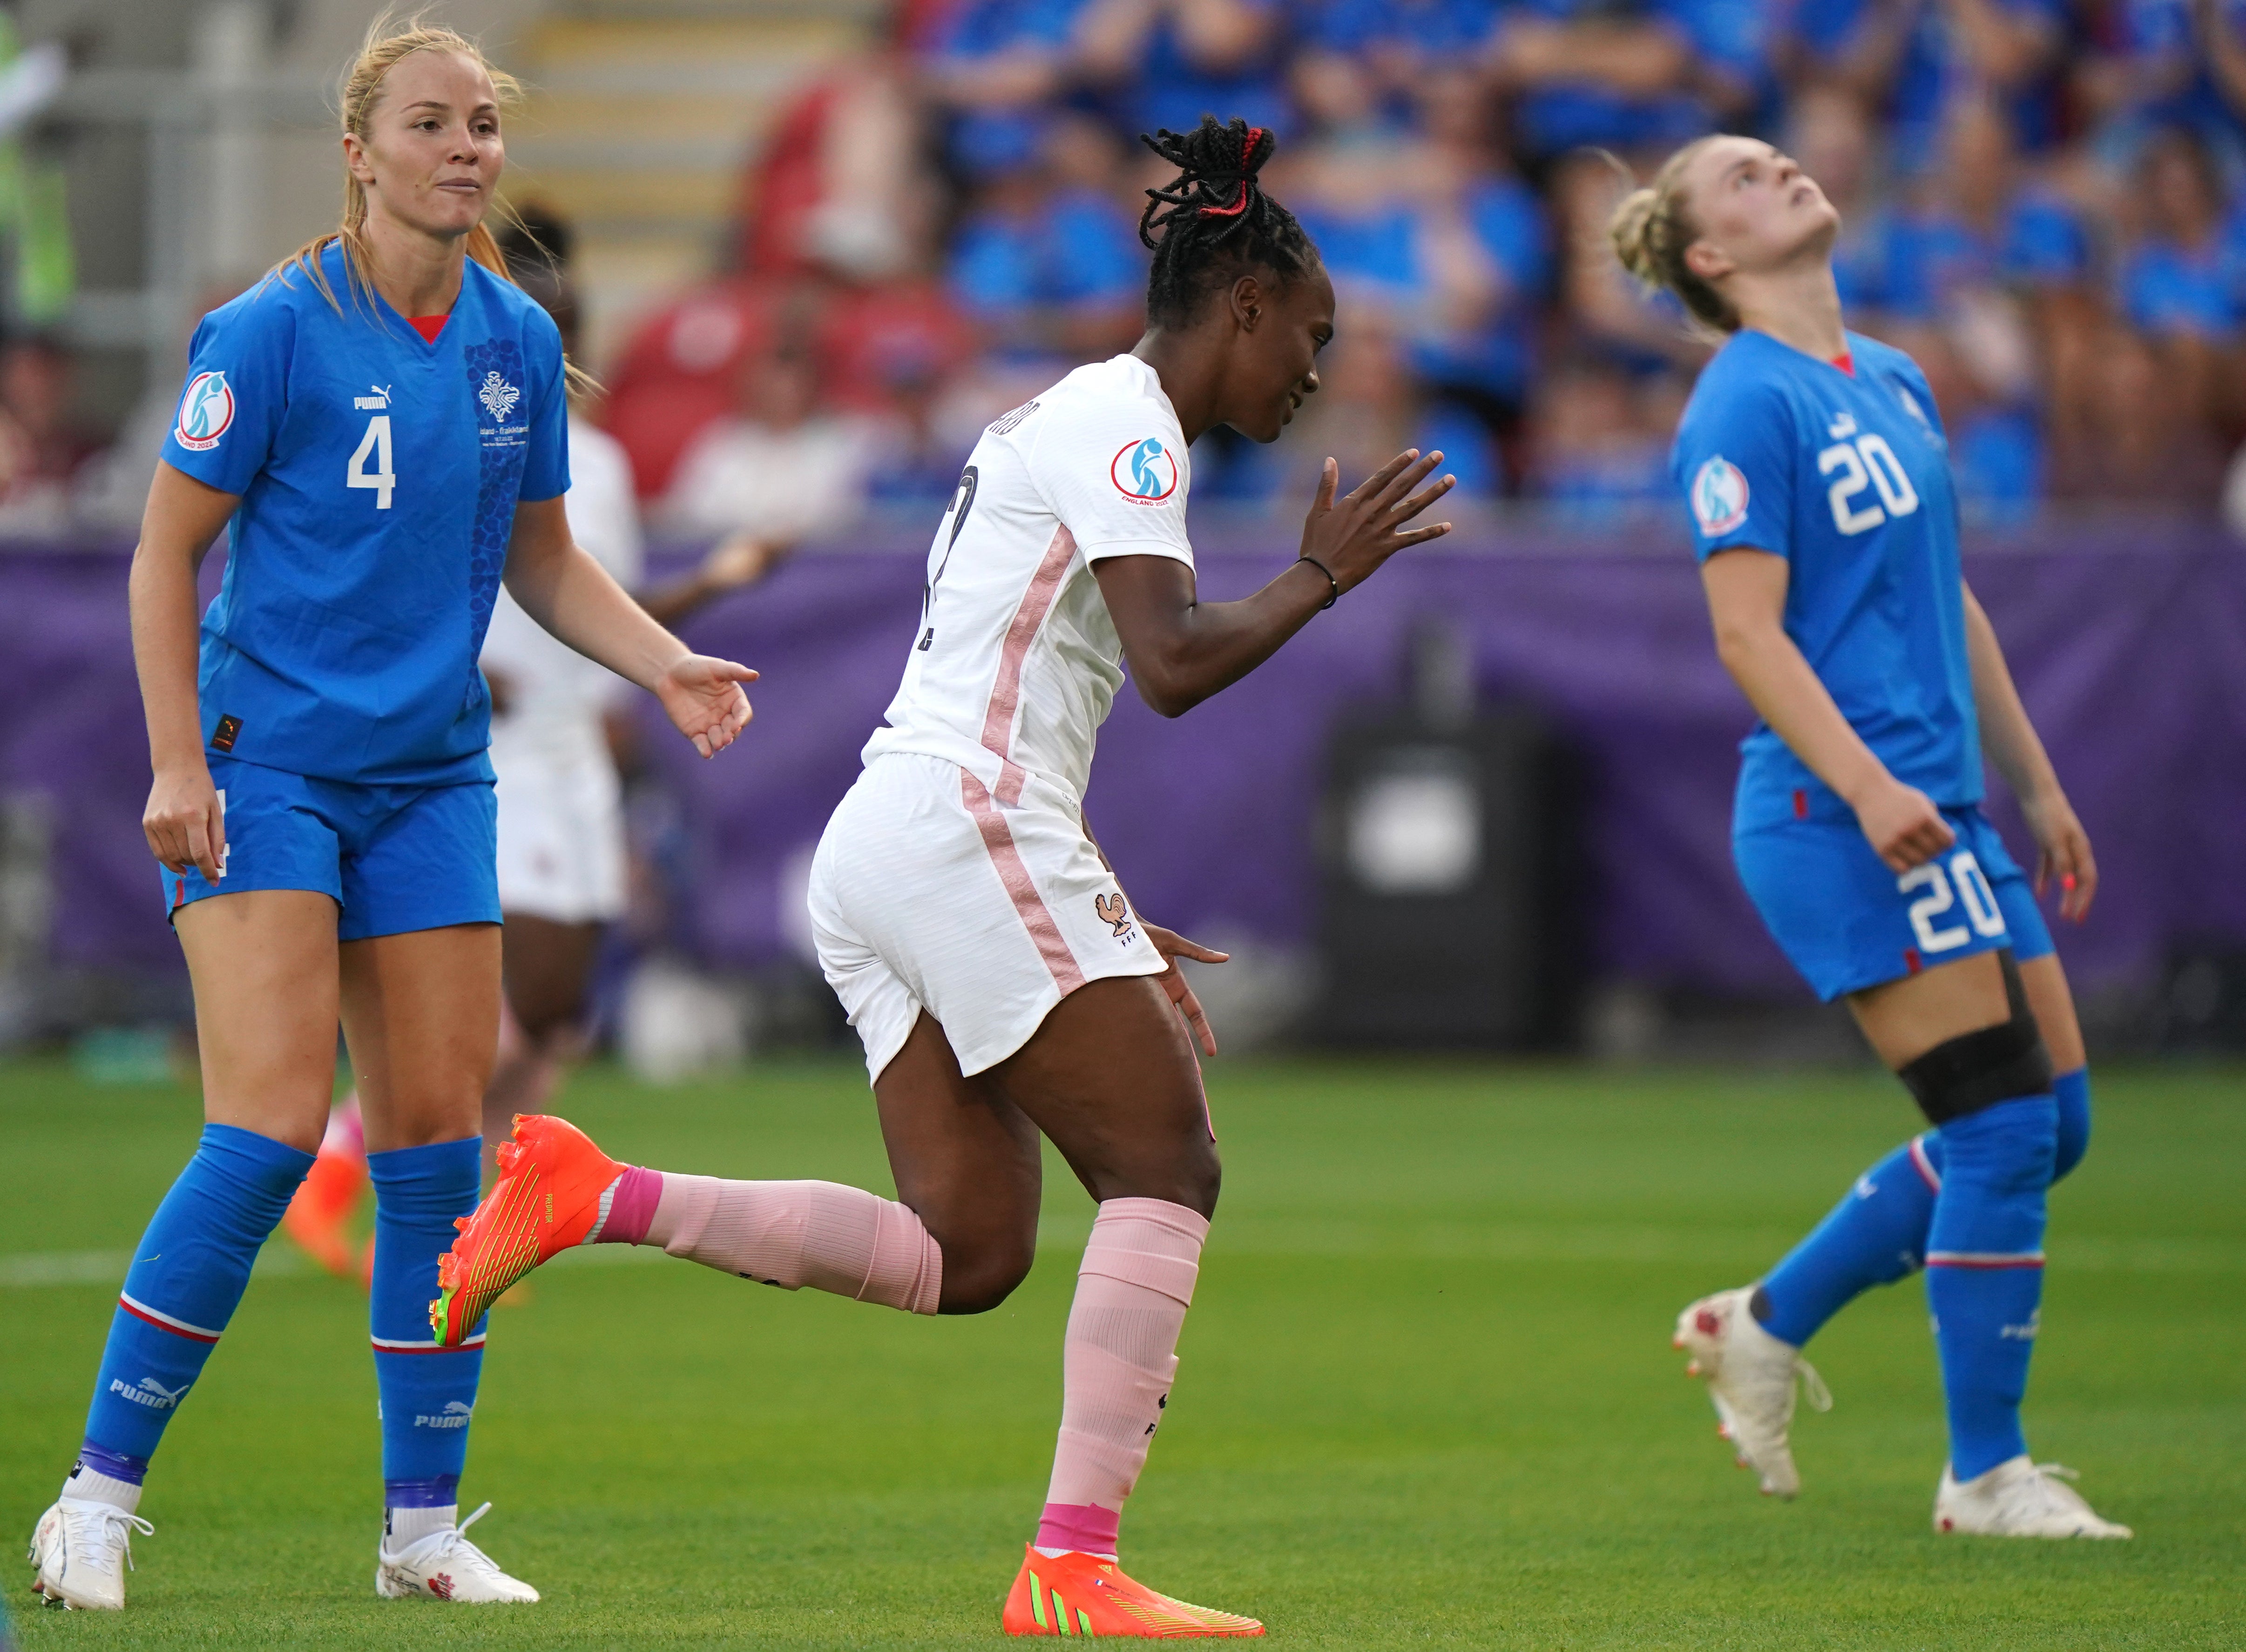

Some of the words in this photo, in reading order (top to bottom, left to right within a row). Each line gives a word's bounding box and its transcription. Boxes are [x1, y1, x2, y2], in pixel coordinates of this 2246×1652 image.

[354, 396, 386, 410] PUMA
[346, 415, 396, 509] 4
[1818, 433, 1919, 536] 20
[1122, 496, 1154, 506] ENGLAND
[1896, 850, 2006, 953] 20
[1121, 931, 1136, 947] FFF
[109, 1378, 169, 1409] PUMA
[414, 1415, 469, 1429] PUMA
